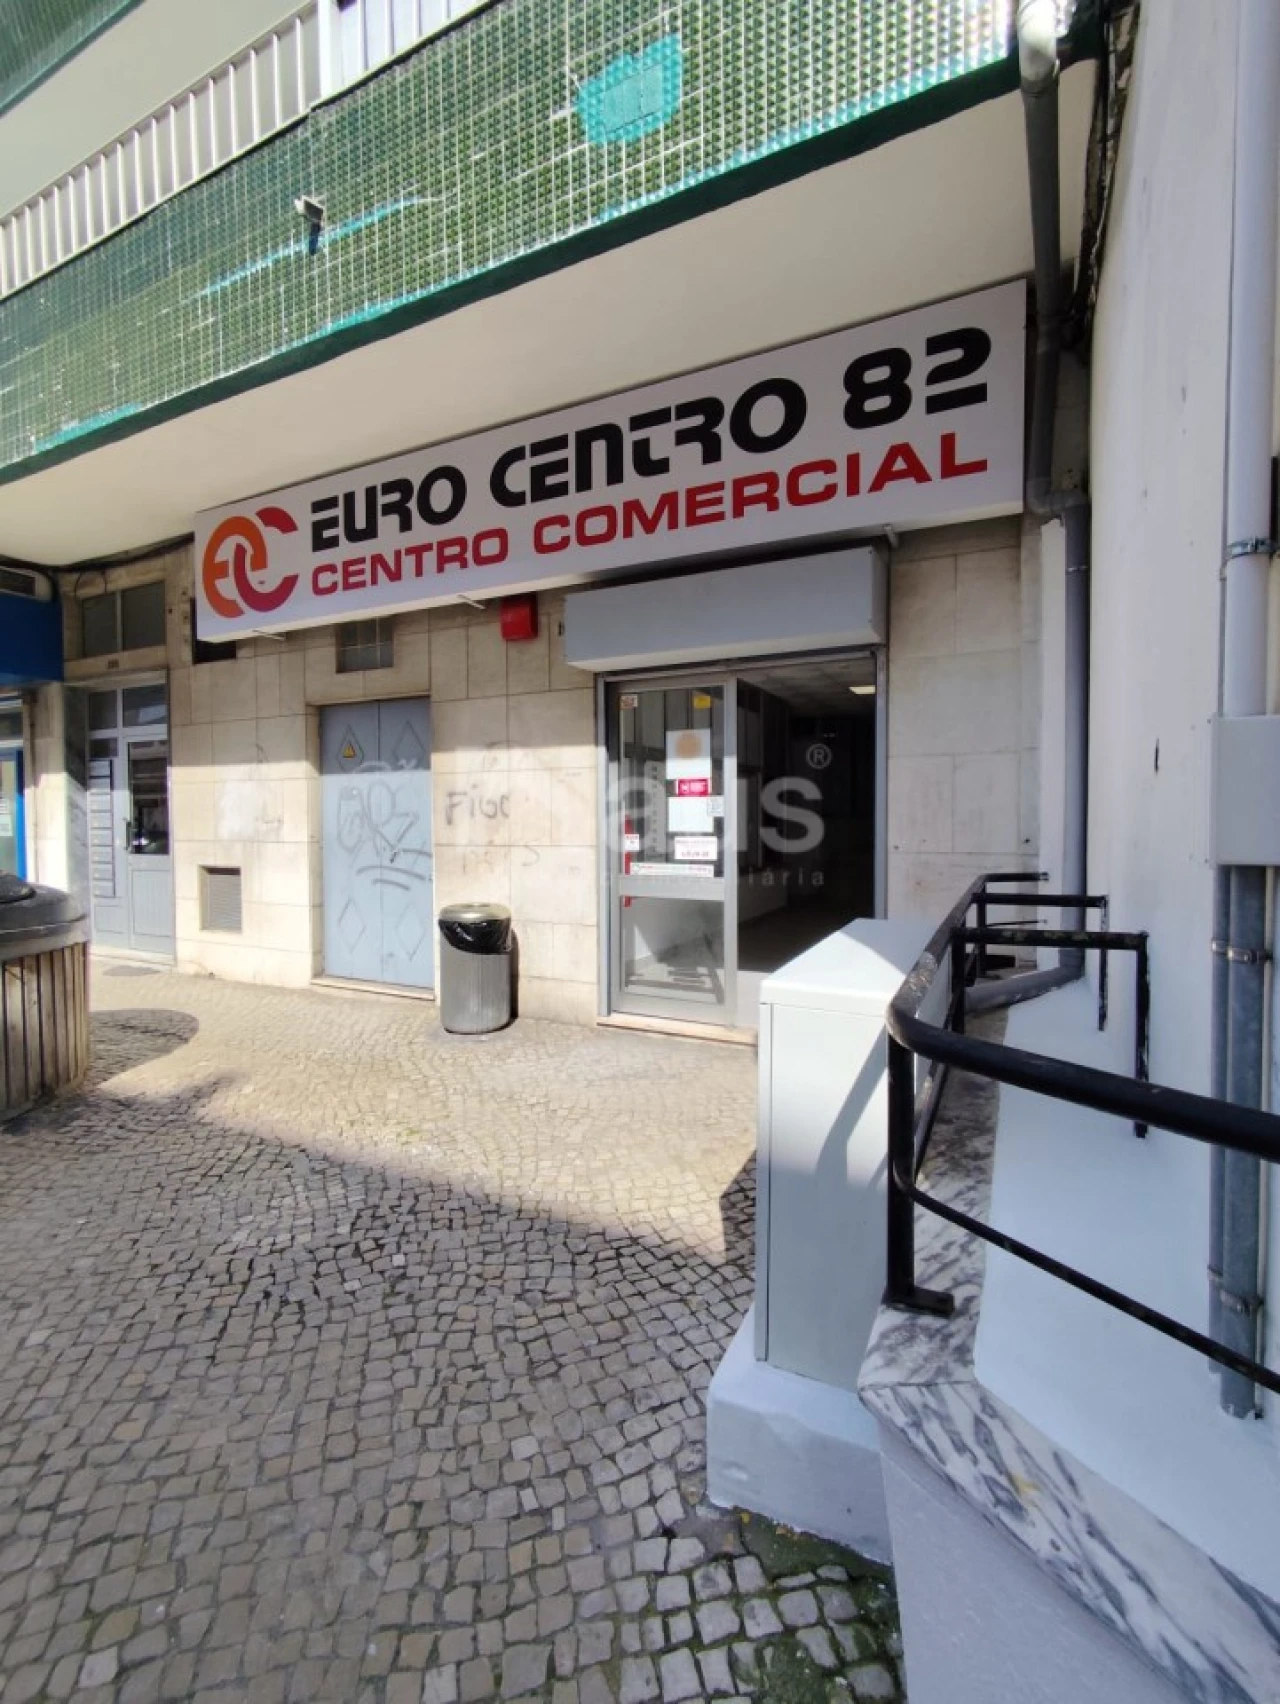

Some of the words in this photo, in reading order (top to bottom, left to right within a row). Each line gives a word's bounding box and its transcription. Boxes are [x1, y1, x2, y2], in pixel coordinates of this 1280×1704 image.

[311, 465, 468, 553] EURO
[489, 377, 807, 508] CENTRO
[842, 326, 992, 430] 82
[311, 527, 509, 596] CENTRO
[532, 433, 988, 555] COMERCIAL
